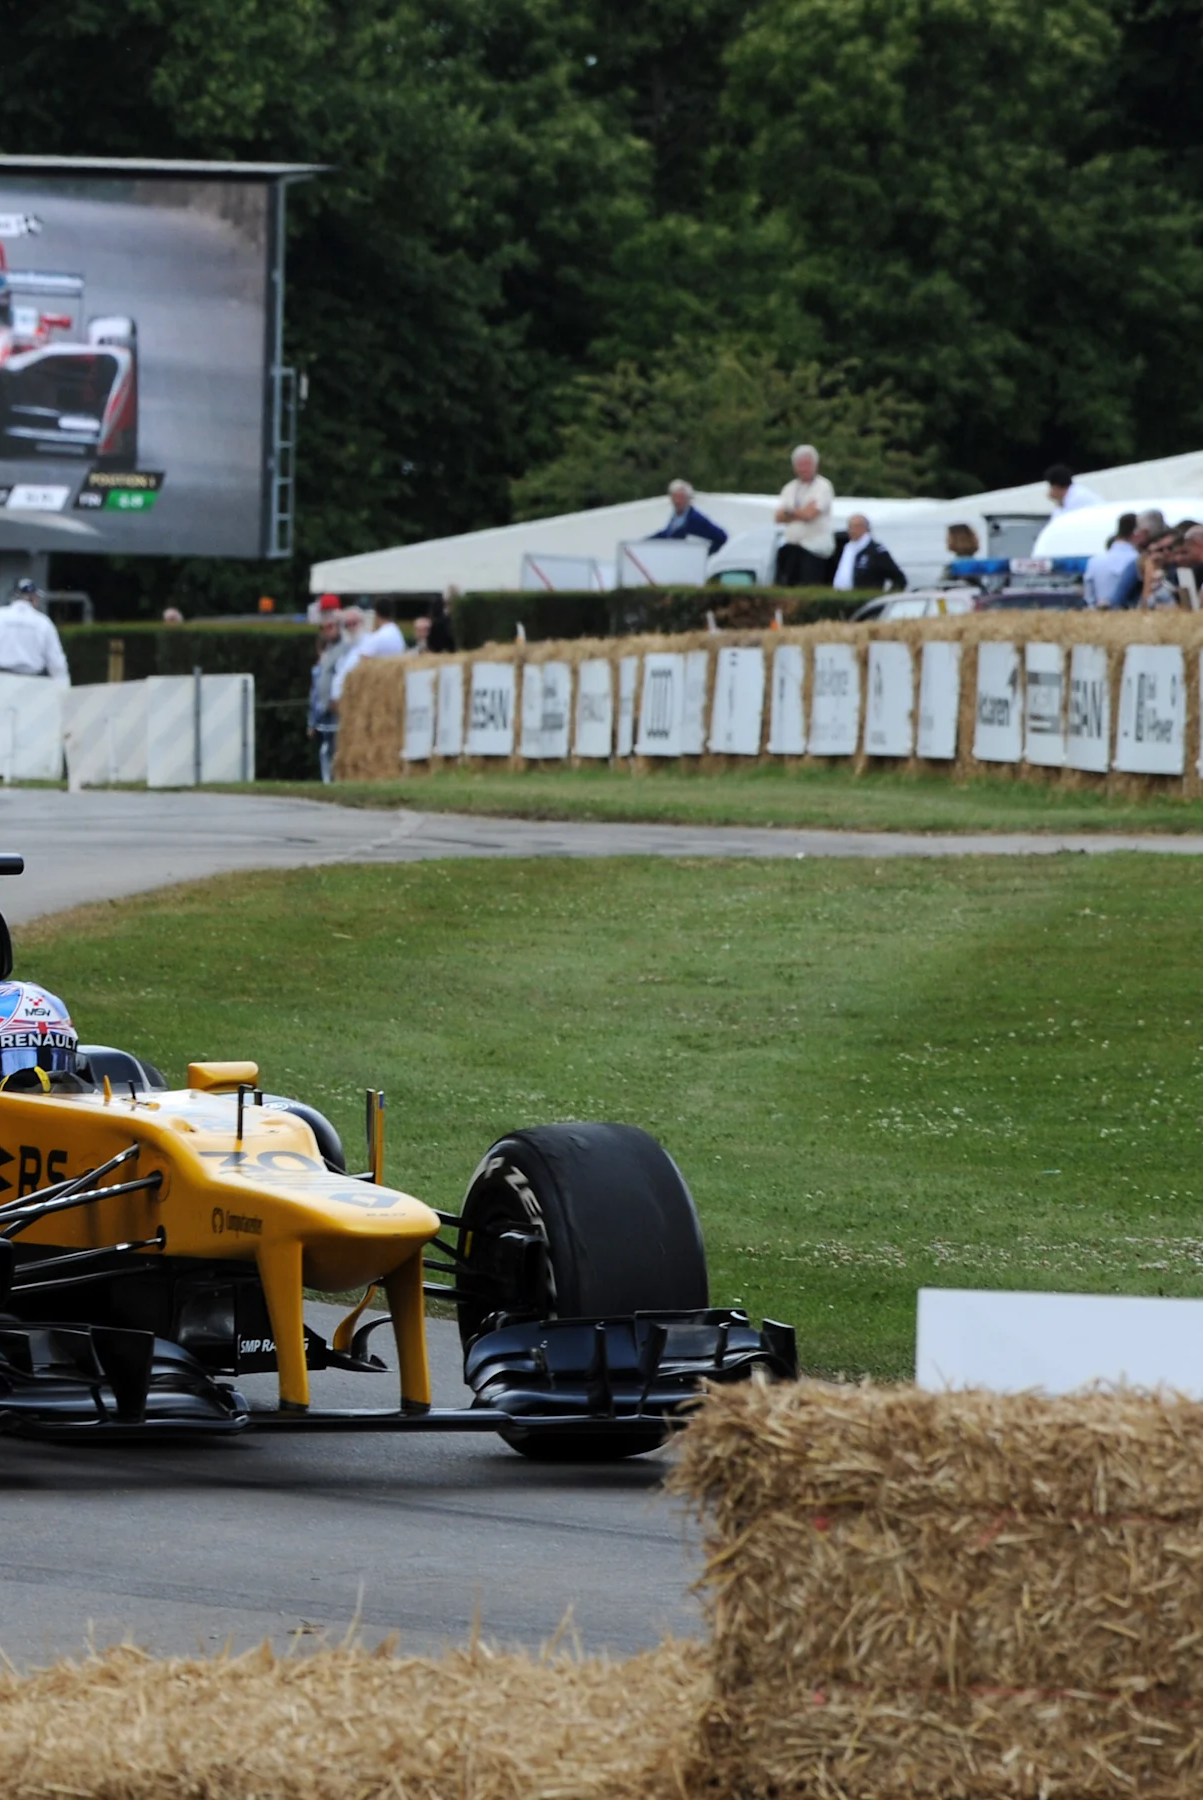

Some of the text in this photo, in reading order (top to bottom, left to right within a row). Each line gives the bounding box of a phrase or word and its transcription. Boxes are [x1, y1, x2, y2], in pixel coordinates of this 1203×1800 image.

[1, 1033, 78, 1049] RENAULT
[18, 1145, 68, 1199] RS
[241, 1338, 309, 1353] SMP RAG
